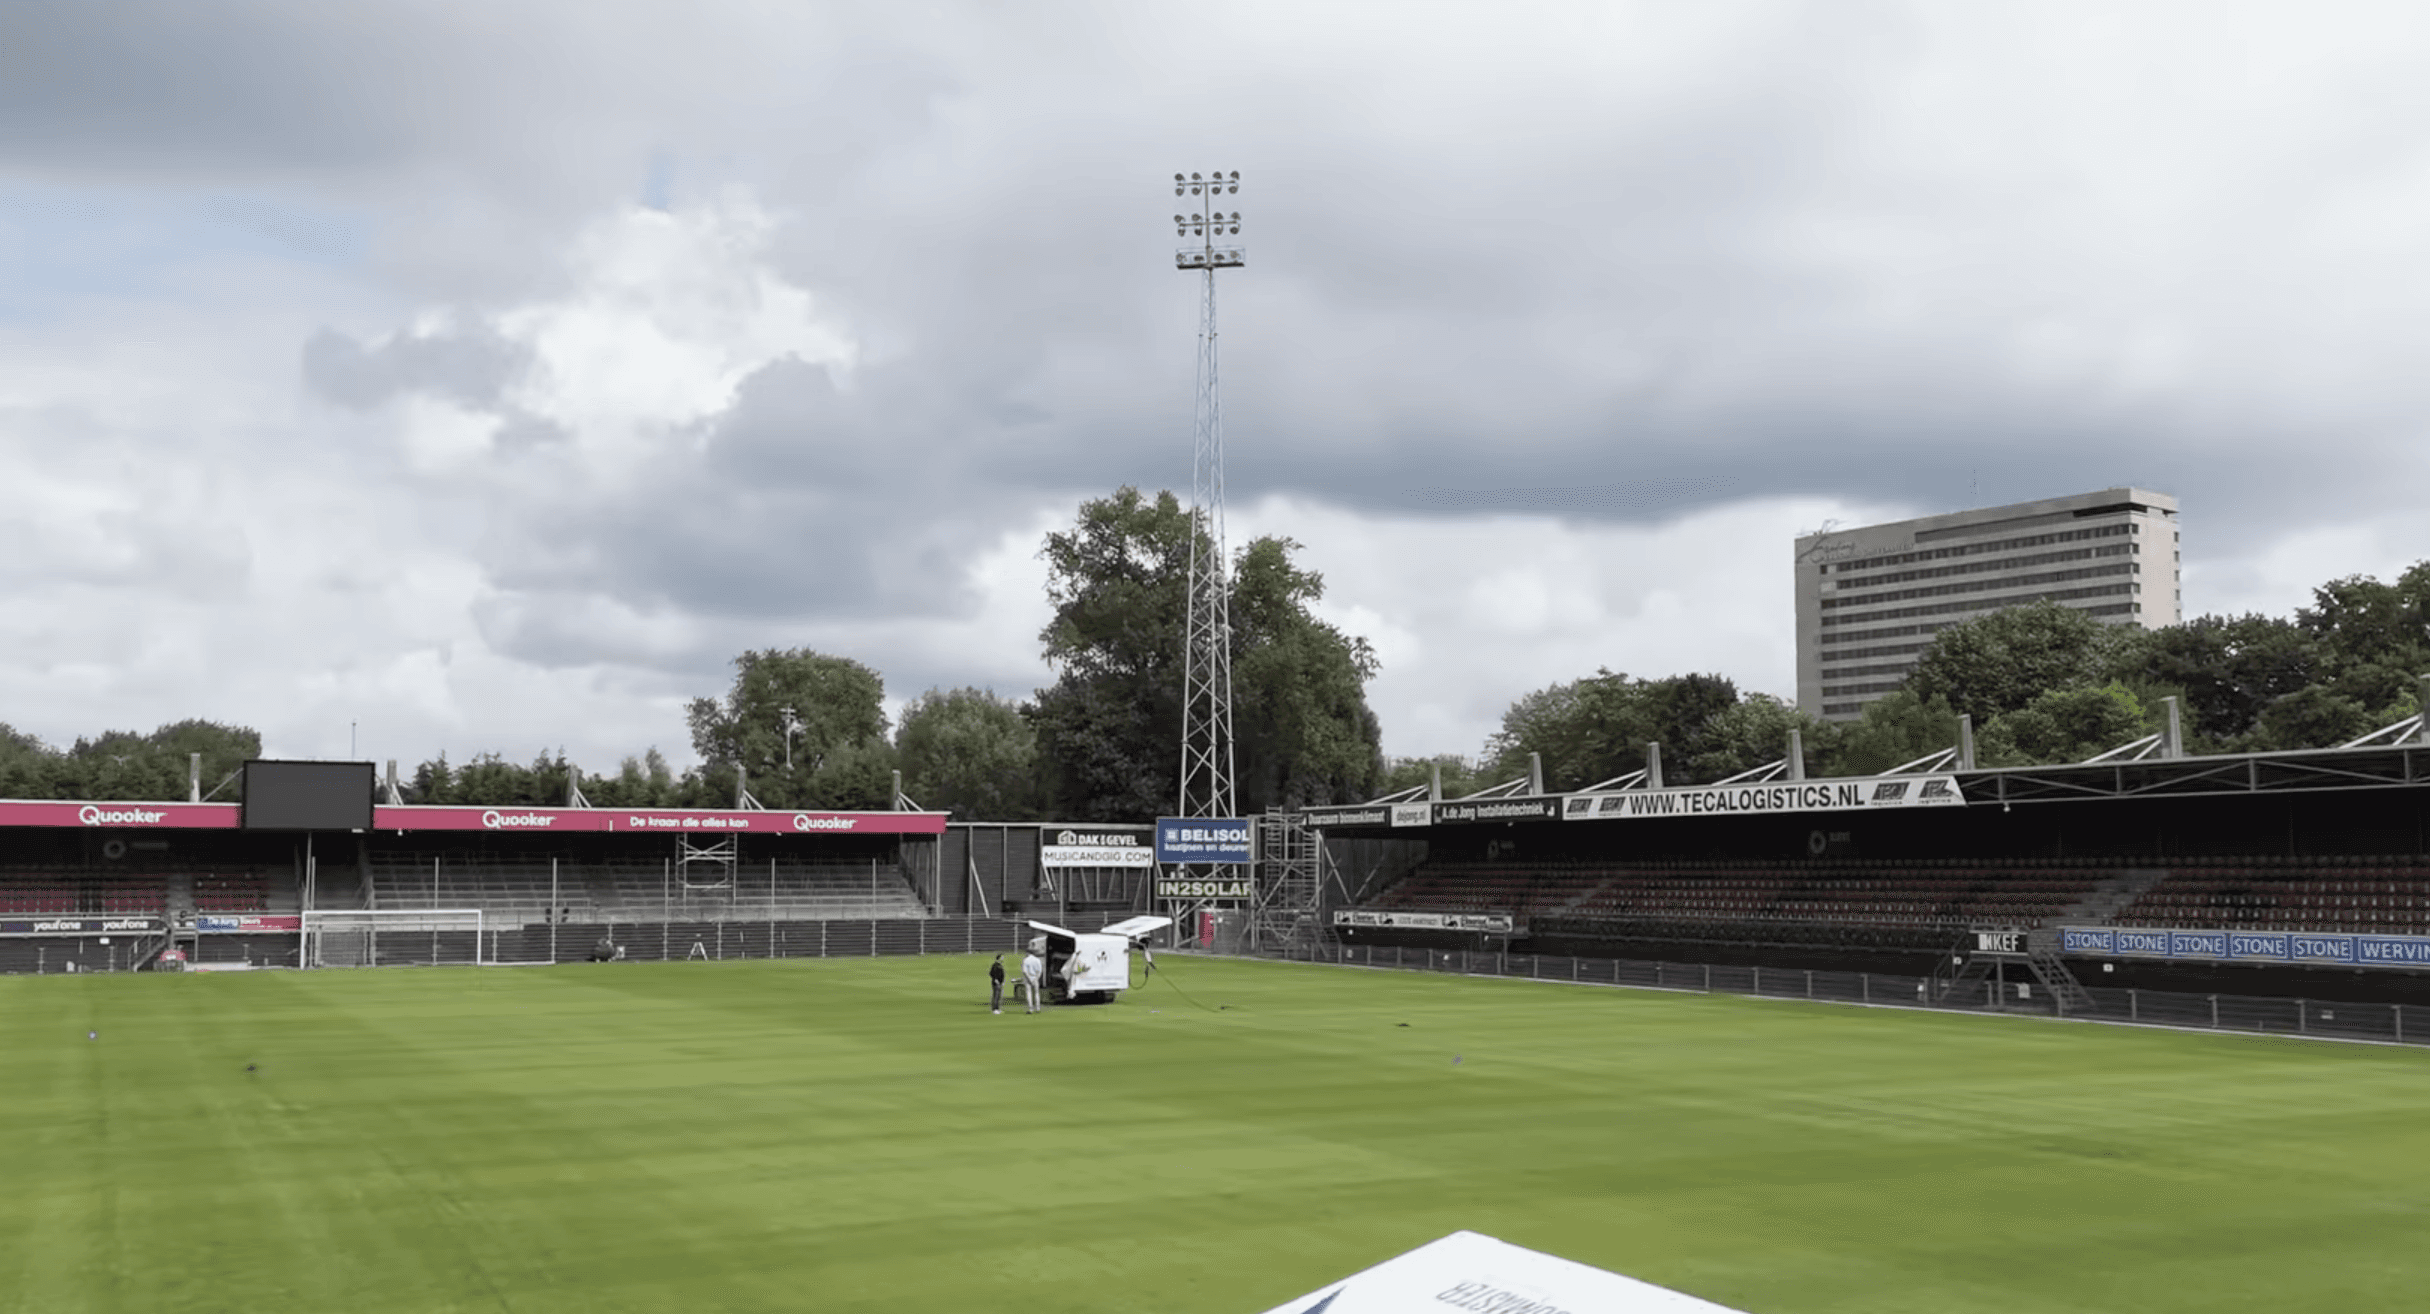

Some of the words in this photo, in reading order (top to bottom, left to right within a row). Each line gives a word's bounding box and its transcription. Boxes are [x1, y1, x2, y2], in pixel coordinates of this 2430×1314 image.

[1629, 783, 1866, 815] WWW.TECALOGISTICS.NL
[79, 805, 166, 826] Quooker
[482, 810, 557, 829] Quooker
[630, 816, 646, 827] De
[648, 816, 680, 827] kraan
[682, 817, 700, 827] die
[701, 817, 727, 828] alles
[728, 817, 749, 828] kan
[793, 814, 858, 832] Quooker
[1078, 834, 1100, 846] DAK
[1106, 834, 1139, 847] GEVEL
[1180, 829, 1250, 842] BELISOL
[33, 919, 82, 933] youfone
[102, 918, 149, 932] youfone
[2066, 933, 2111, 948] STONE
[2120, 935, 2165, 950] STONE
[2175, 936, 2223, 952] STONE
[2234, 938, 2284, 954] STONE
[2296, 940, 2350, 956] STONE
